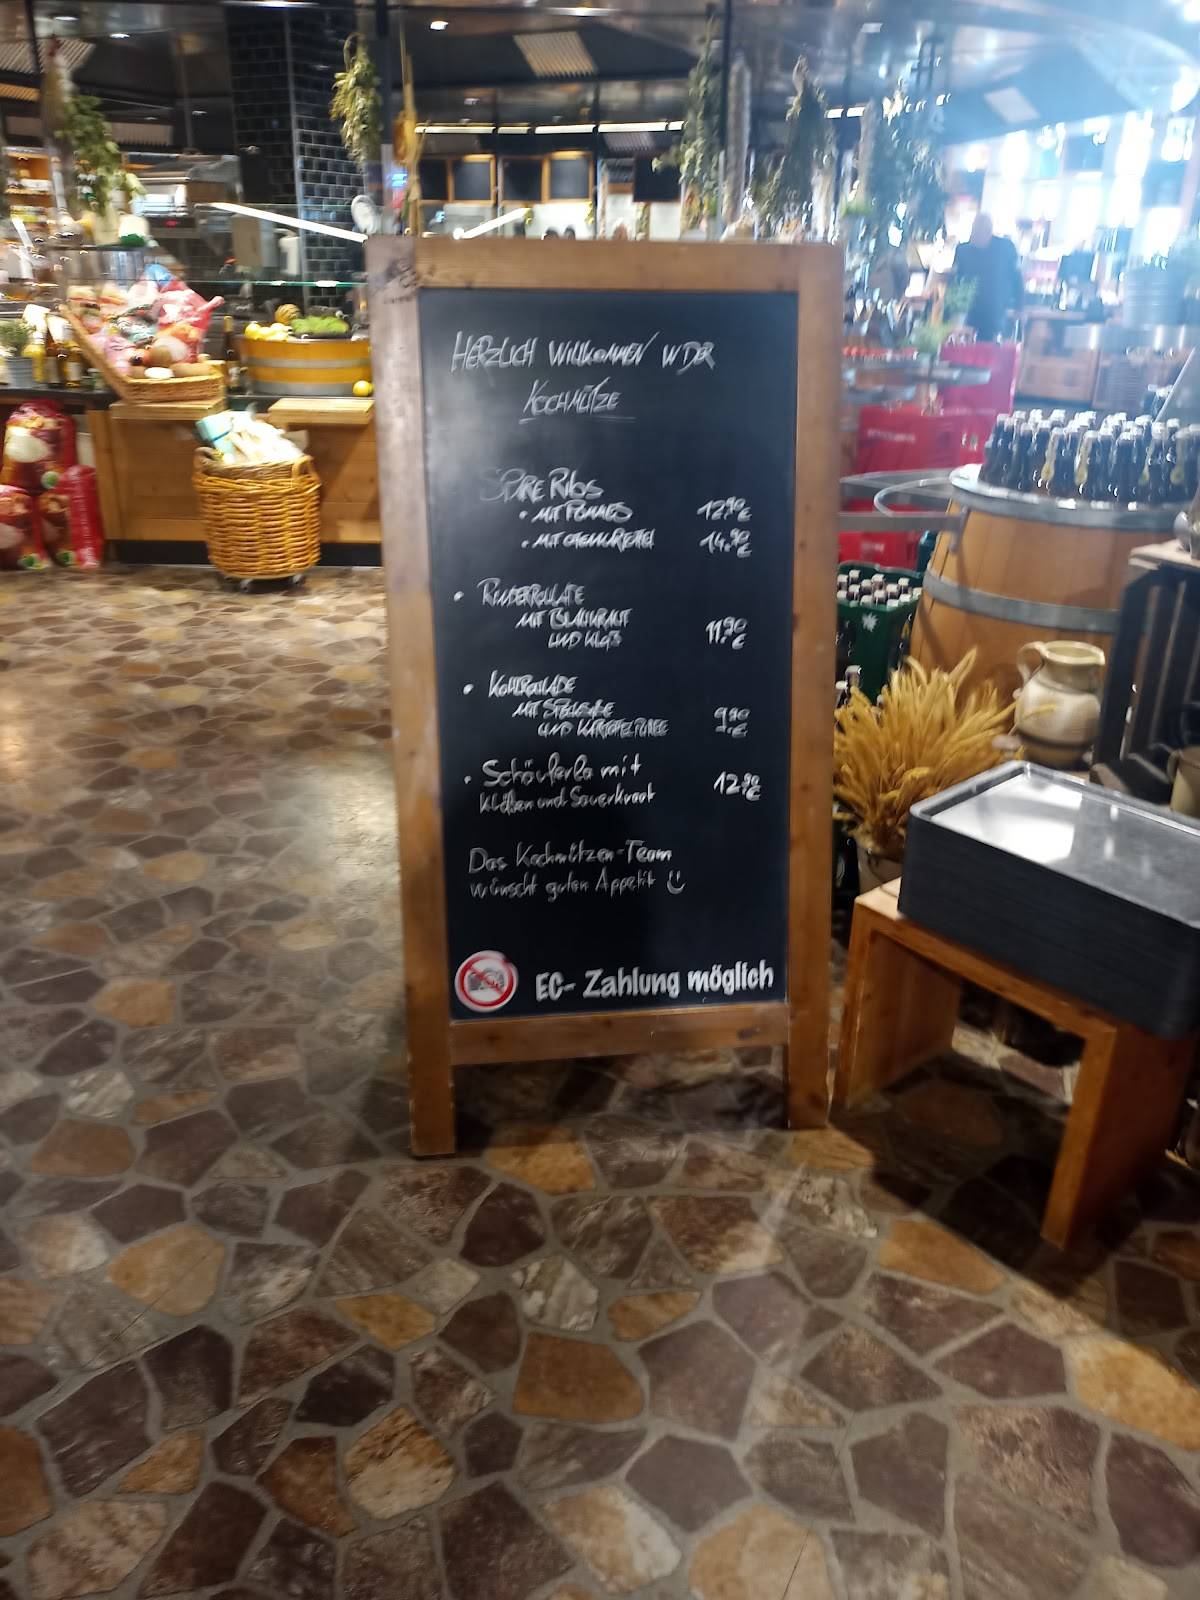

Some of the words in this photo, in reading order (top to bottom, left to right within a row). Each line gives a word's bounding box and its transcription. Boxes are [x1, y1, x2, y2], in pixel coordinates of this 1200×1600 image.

[451, 331, 539, 372] HERZLICH
[549, 331, 660, 367] WILLKOMMEN
[600, 753, 642, 779] mit
[537, 787, 568, 808] und
[468, 847, 509, 875] Das
[470, 873, 538, 898] wünscht
[545, 871, 590, 902] guten
[595, 867, 656, 896] Appetit
[582, 966, 681, 998] Zahlung
[687, 959, 774, 994] möglich
